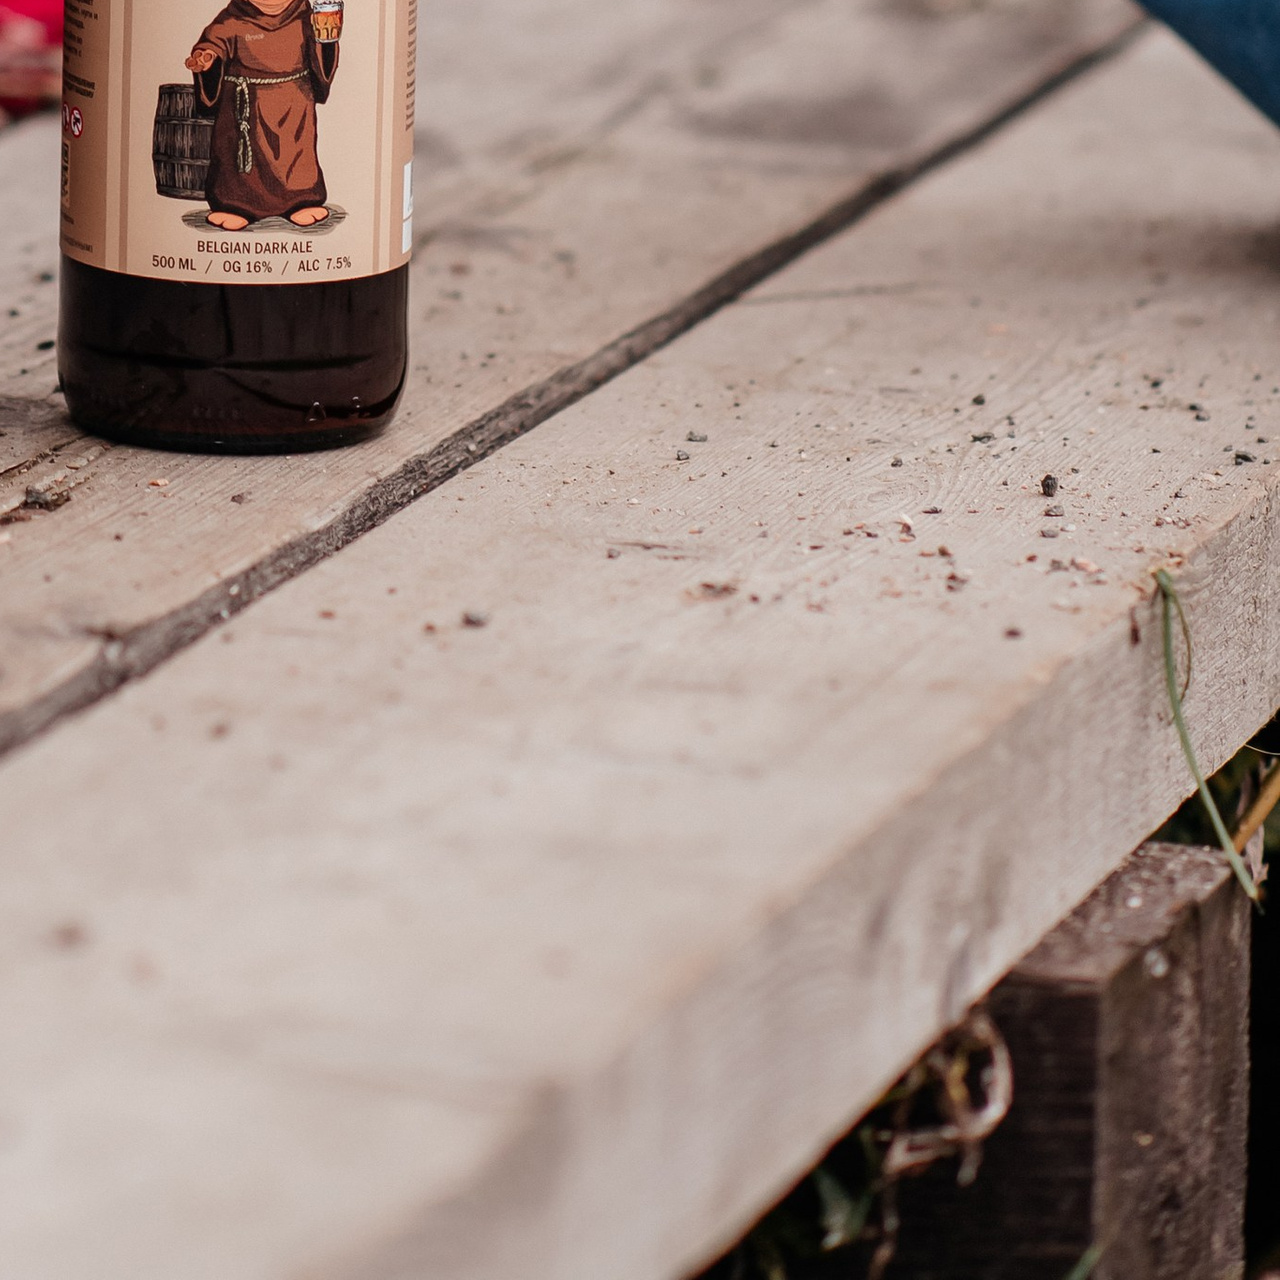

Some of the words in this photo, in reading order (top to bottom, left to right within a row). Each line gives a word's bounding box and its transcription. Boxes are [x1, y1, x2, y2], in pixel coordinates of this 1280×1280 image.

[197, 240, 251, 254] BELGIAN
[255, 241, 289, 254] DARK
[291, 241, 313, 253] ALE
[152, 255, 175, 269] 500
[178, 258, 197, 271] ML
[205, 260, 213, 274] /
[223, 260, 241, 273] OG
[246, 261, 273, 273] 16%
[281, 261, 289, 275] /
[298, 259, 320, 272] ALC
[326, 256, 352, 270] 7.5%
